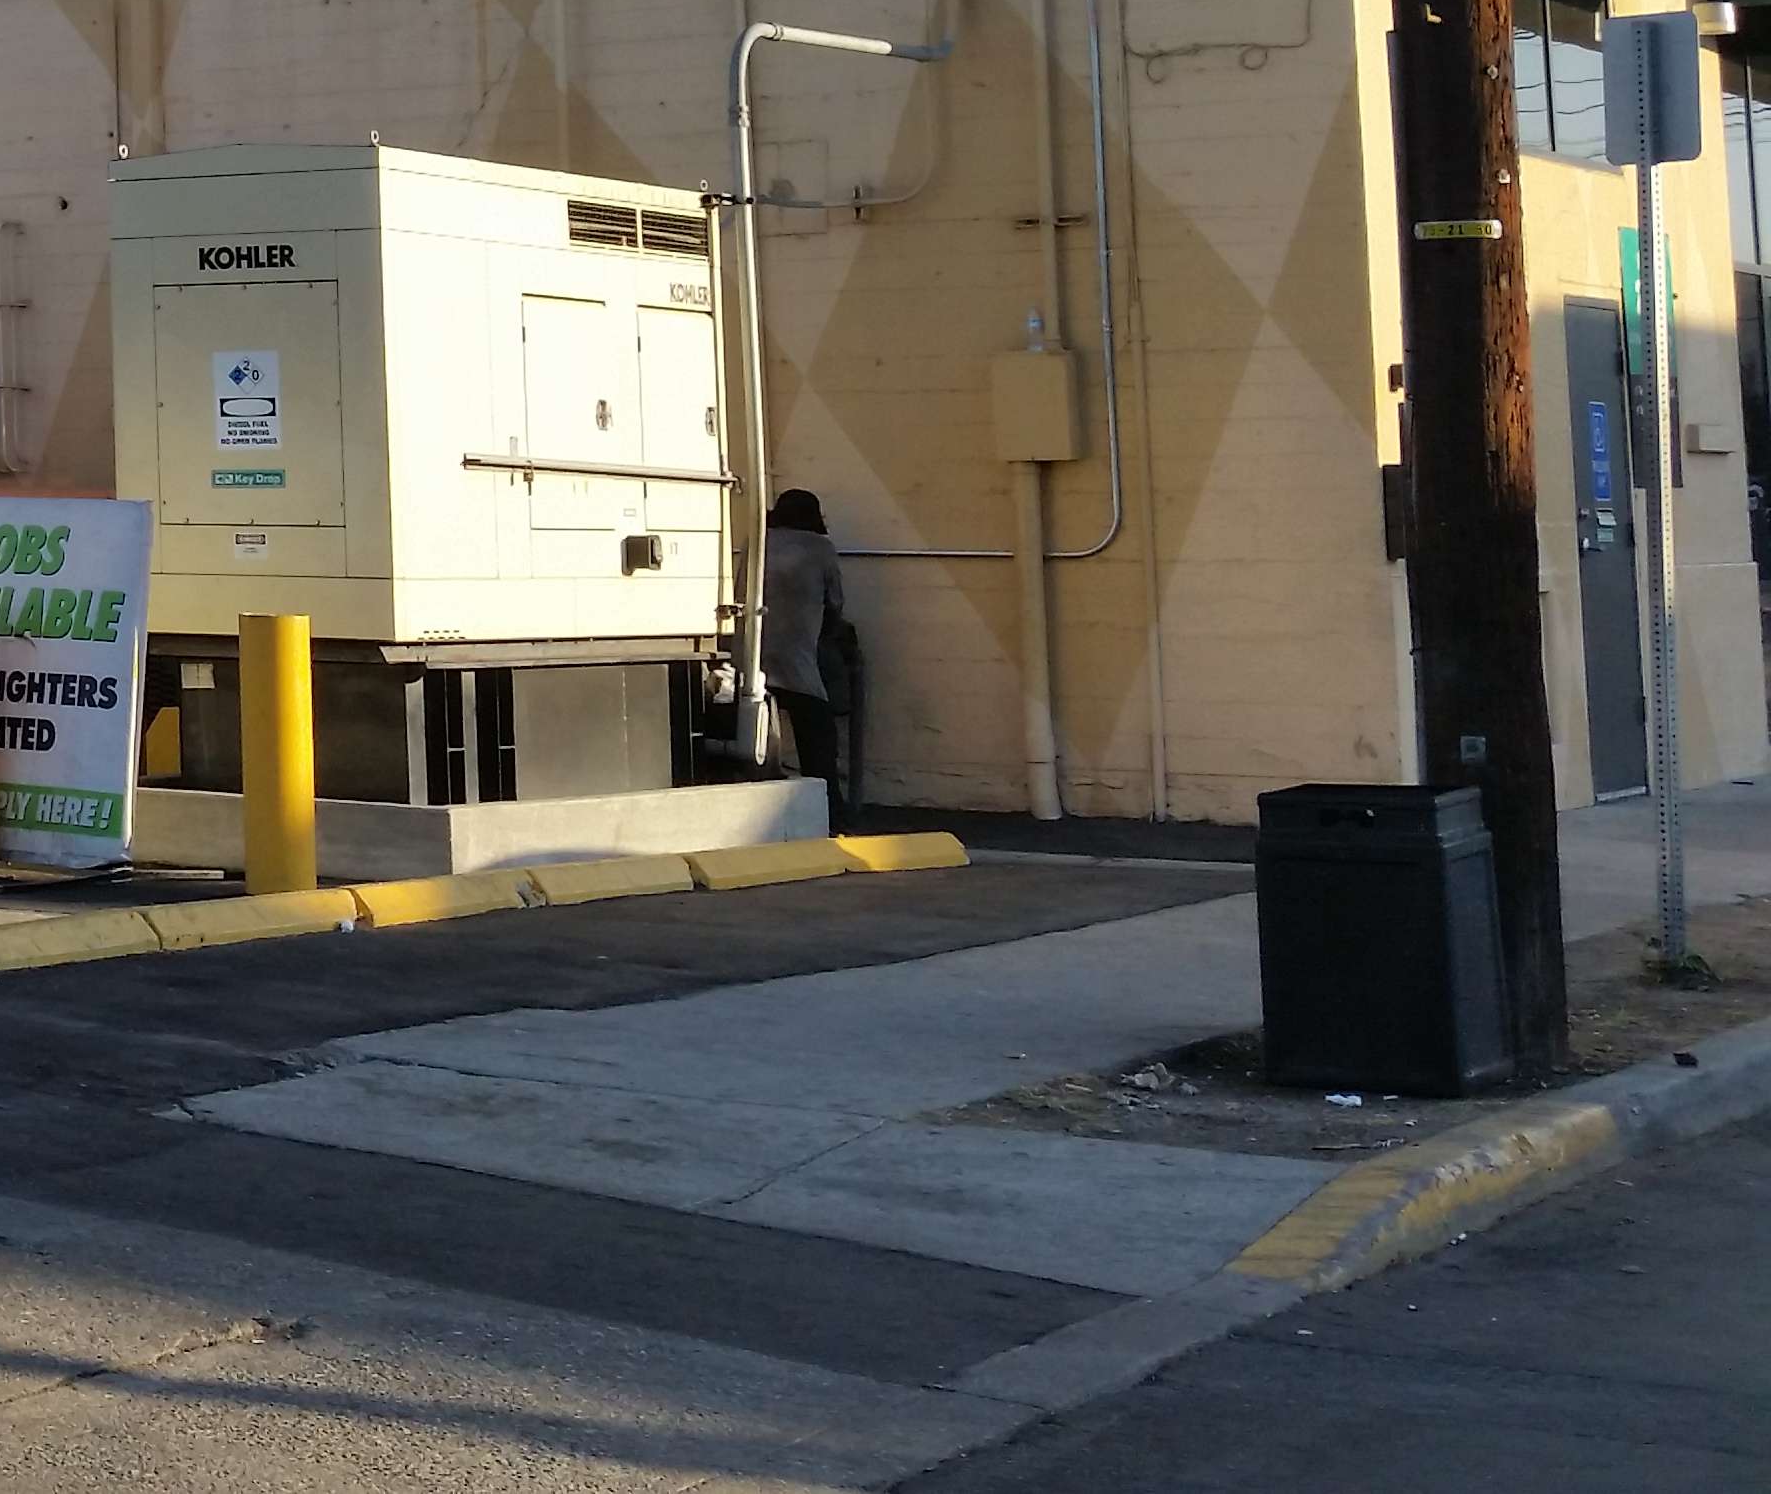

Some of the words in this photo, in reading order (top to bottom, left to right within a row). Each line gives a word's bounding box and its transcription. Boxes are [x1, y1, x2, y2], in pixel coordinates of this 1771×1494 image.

[198, 244, 296, 270] KOHLER
[669, 282, 710, 305] KOHLER
[234, 474, 254, 485] Key
[256, 473, 281, 484] Drop
